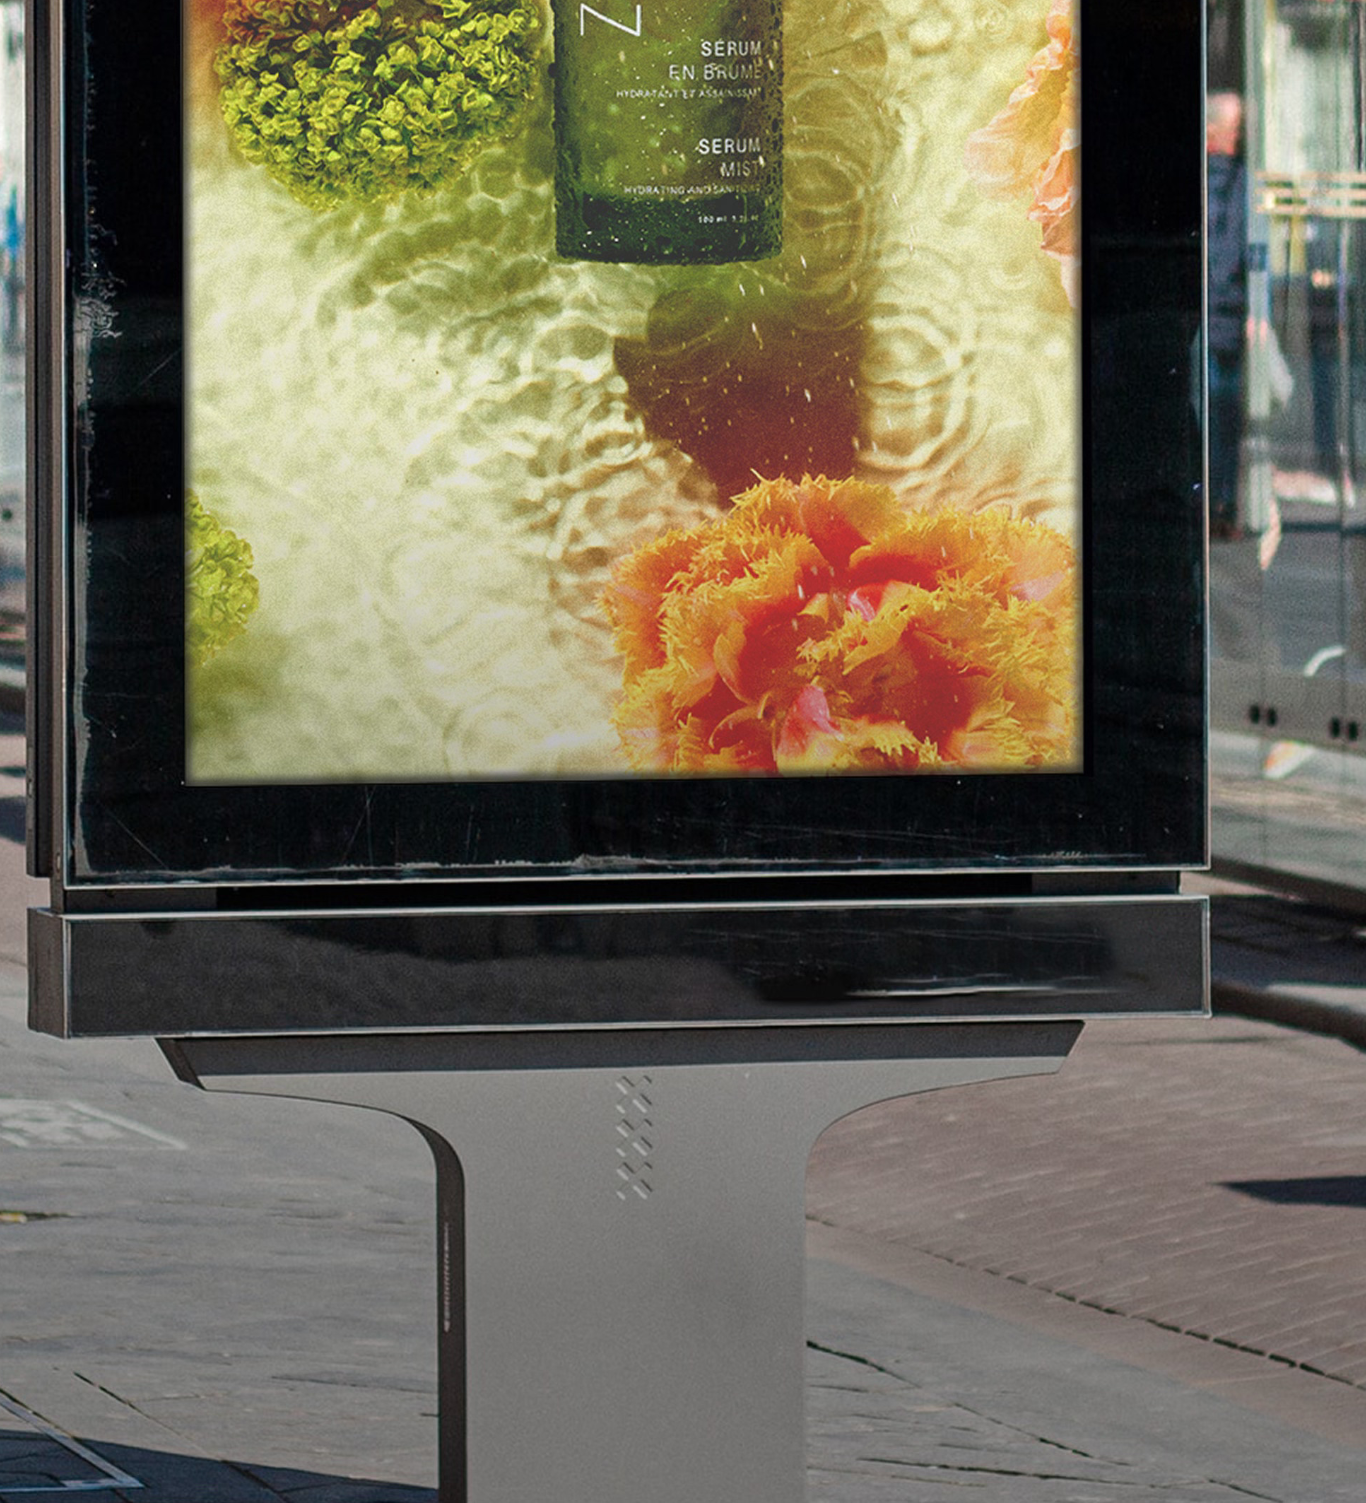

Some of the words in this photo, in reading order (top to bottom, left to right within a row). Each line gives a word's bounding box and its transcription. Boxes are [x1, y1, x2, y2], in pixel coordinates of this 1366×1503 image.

[669, 64, 695, 81] EN
[704, 64, 763, 81] BRUME
[698, 137, 761, 155] SERUM
[720, 160, 760, 177] MIST
